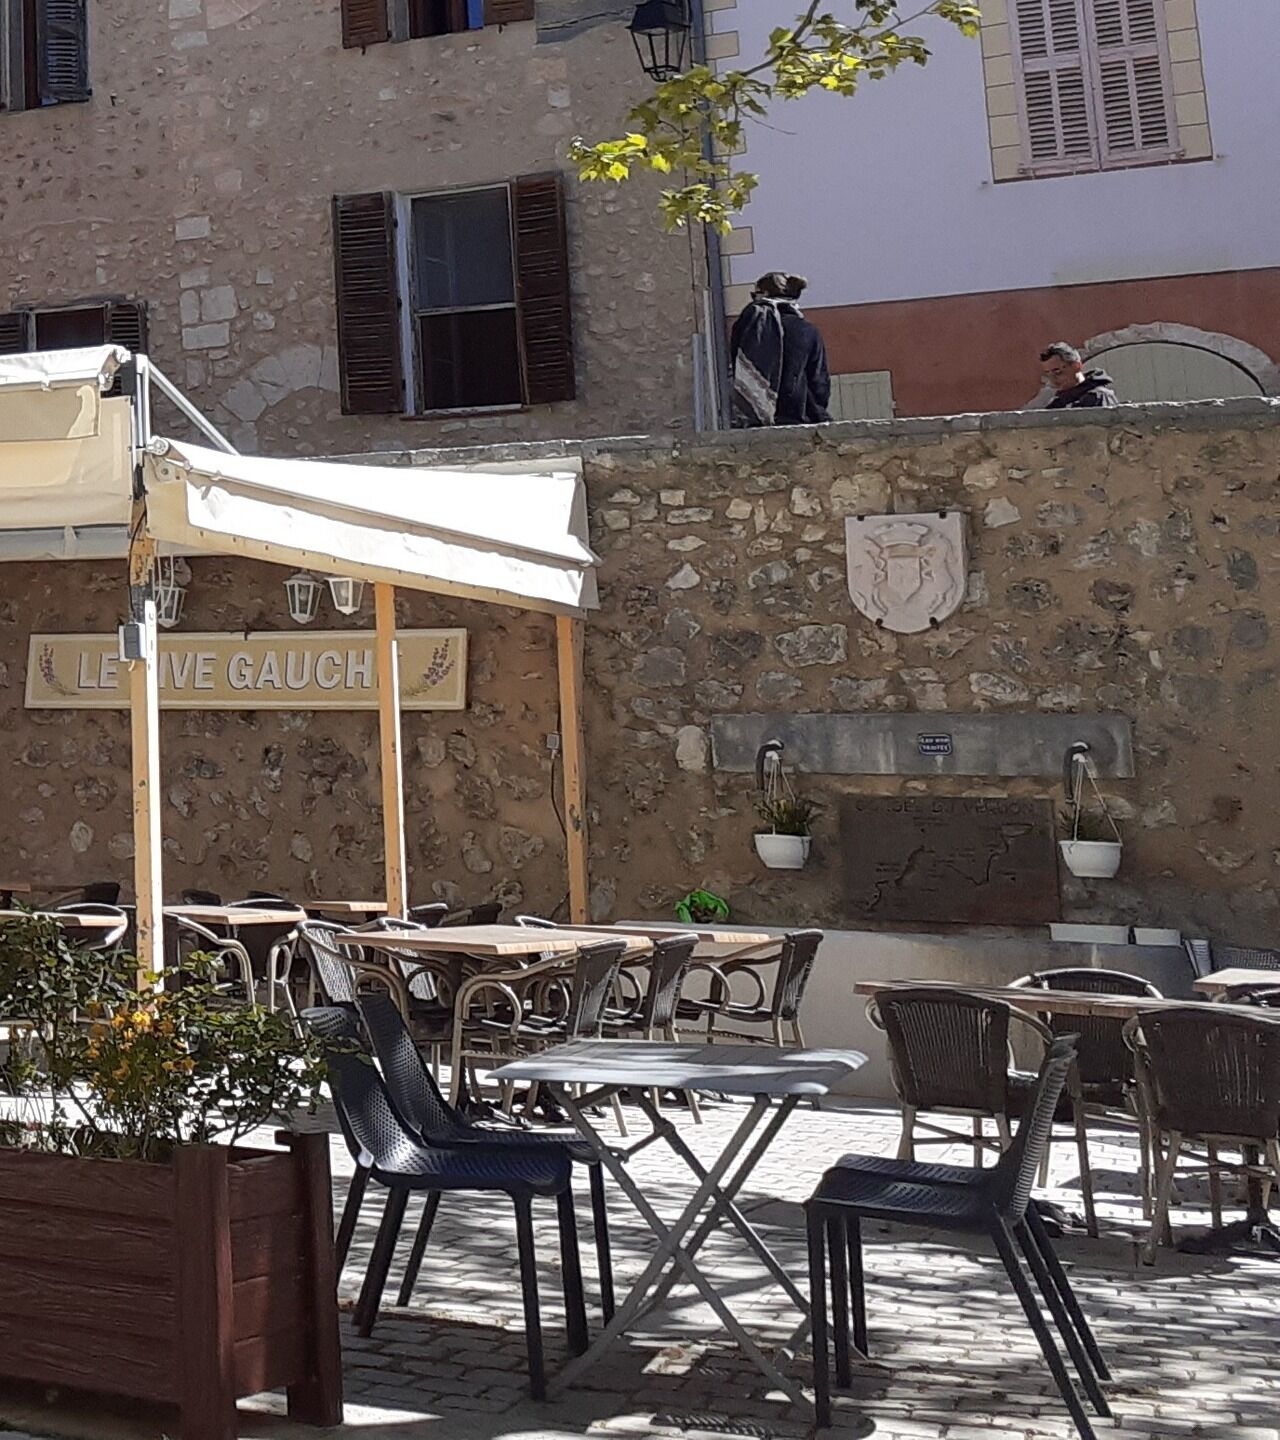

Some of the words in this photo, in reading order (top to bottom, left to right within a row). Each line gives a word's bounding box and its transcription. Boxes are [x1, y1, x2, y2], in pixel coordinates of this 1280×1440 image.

[78, 650, 119, 689] LE
[159, 649, 217, 689] IVE
[227, 649, 381, 689] GAUCH
